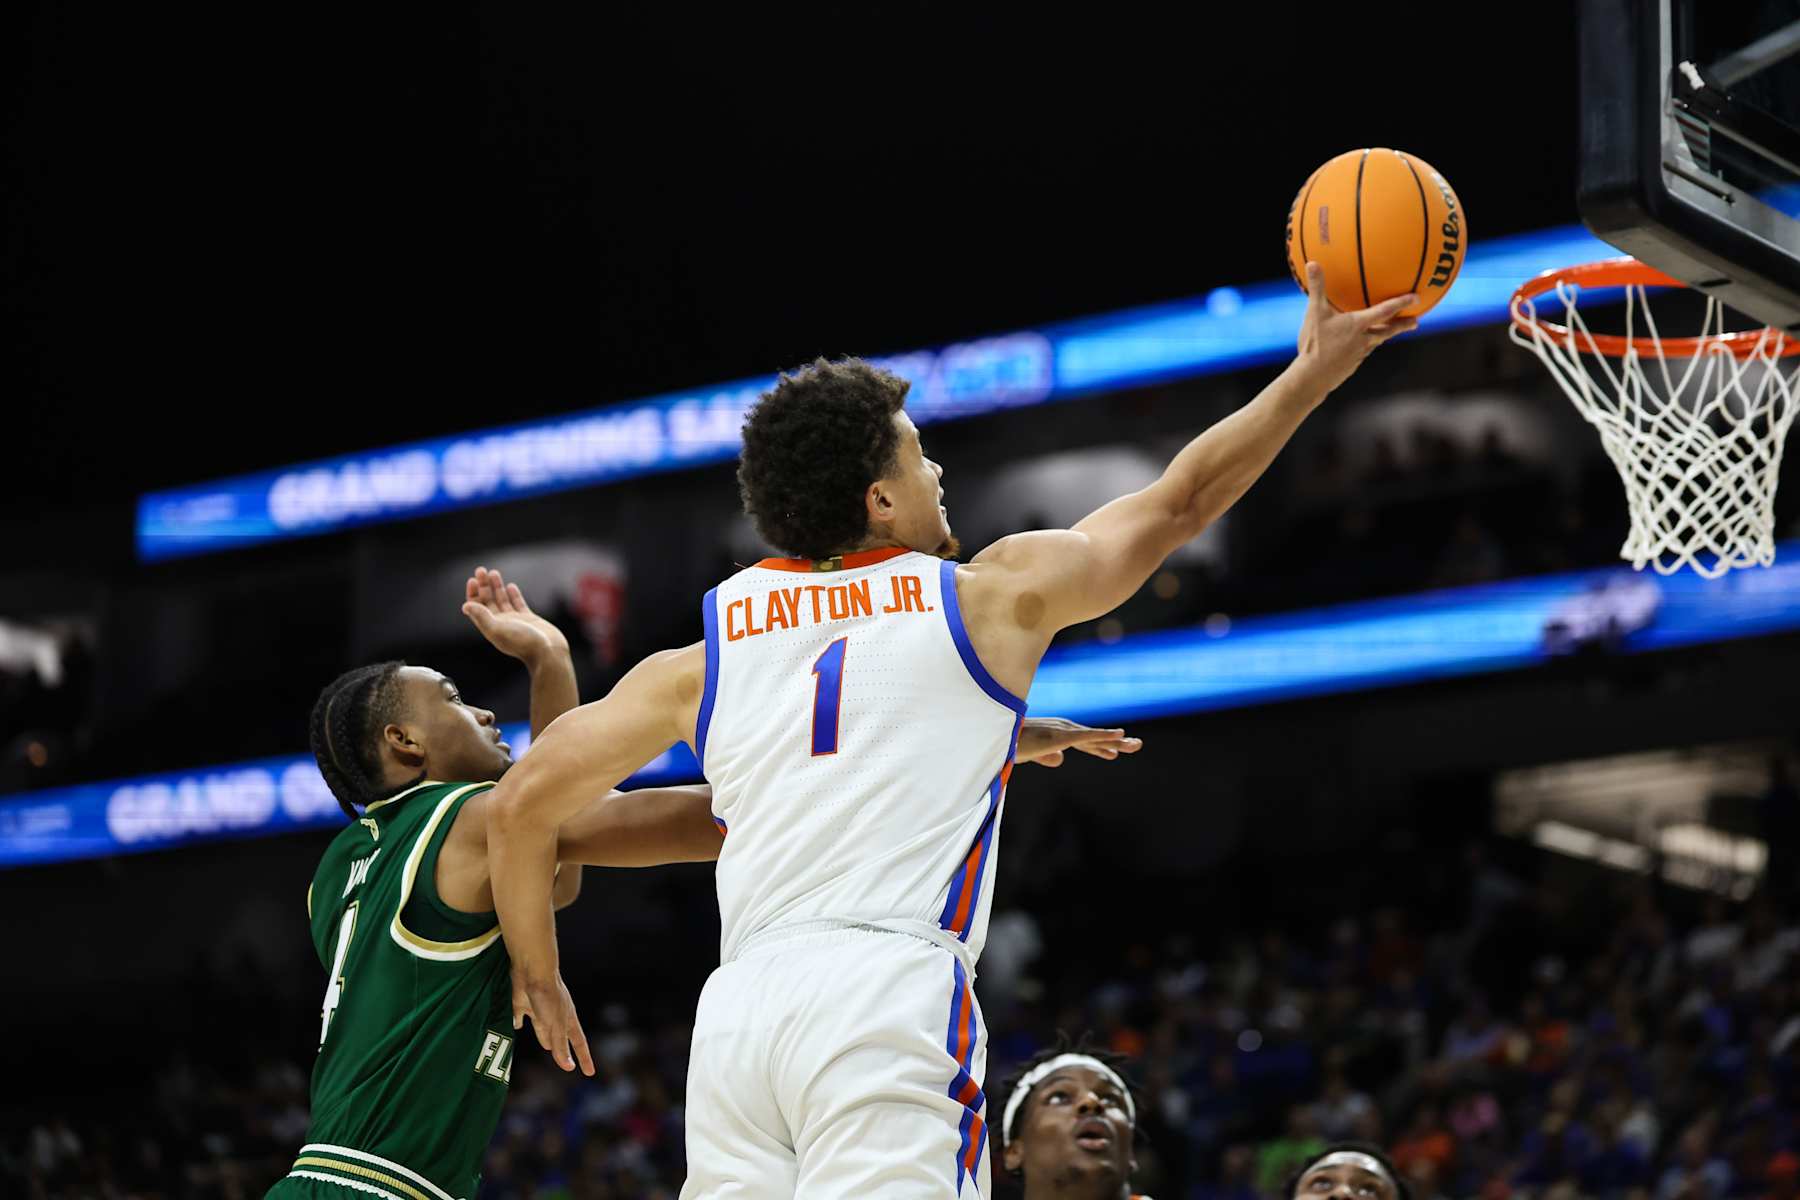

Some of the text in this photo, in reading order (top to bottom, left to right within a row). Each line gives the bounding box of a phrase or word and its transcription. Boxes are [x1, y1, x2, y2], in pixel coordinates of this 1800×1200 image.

[726, 575, 934, 642] CLAYTON JR.
[811, 636, 848, 757] 1
[473, 1029, 512, 1086] FL
